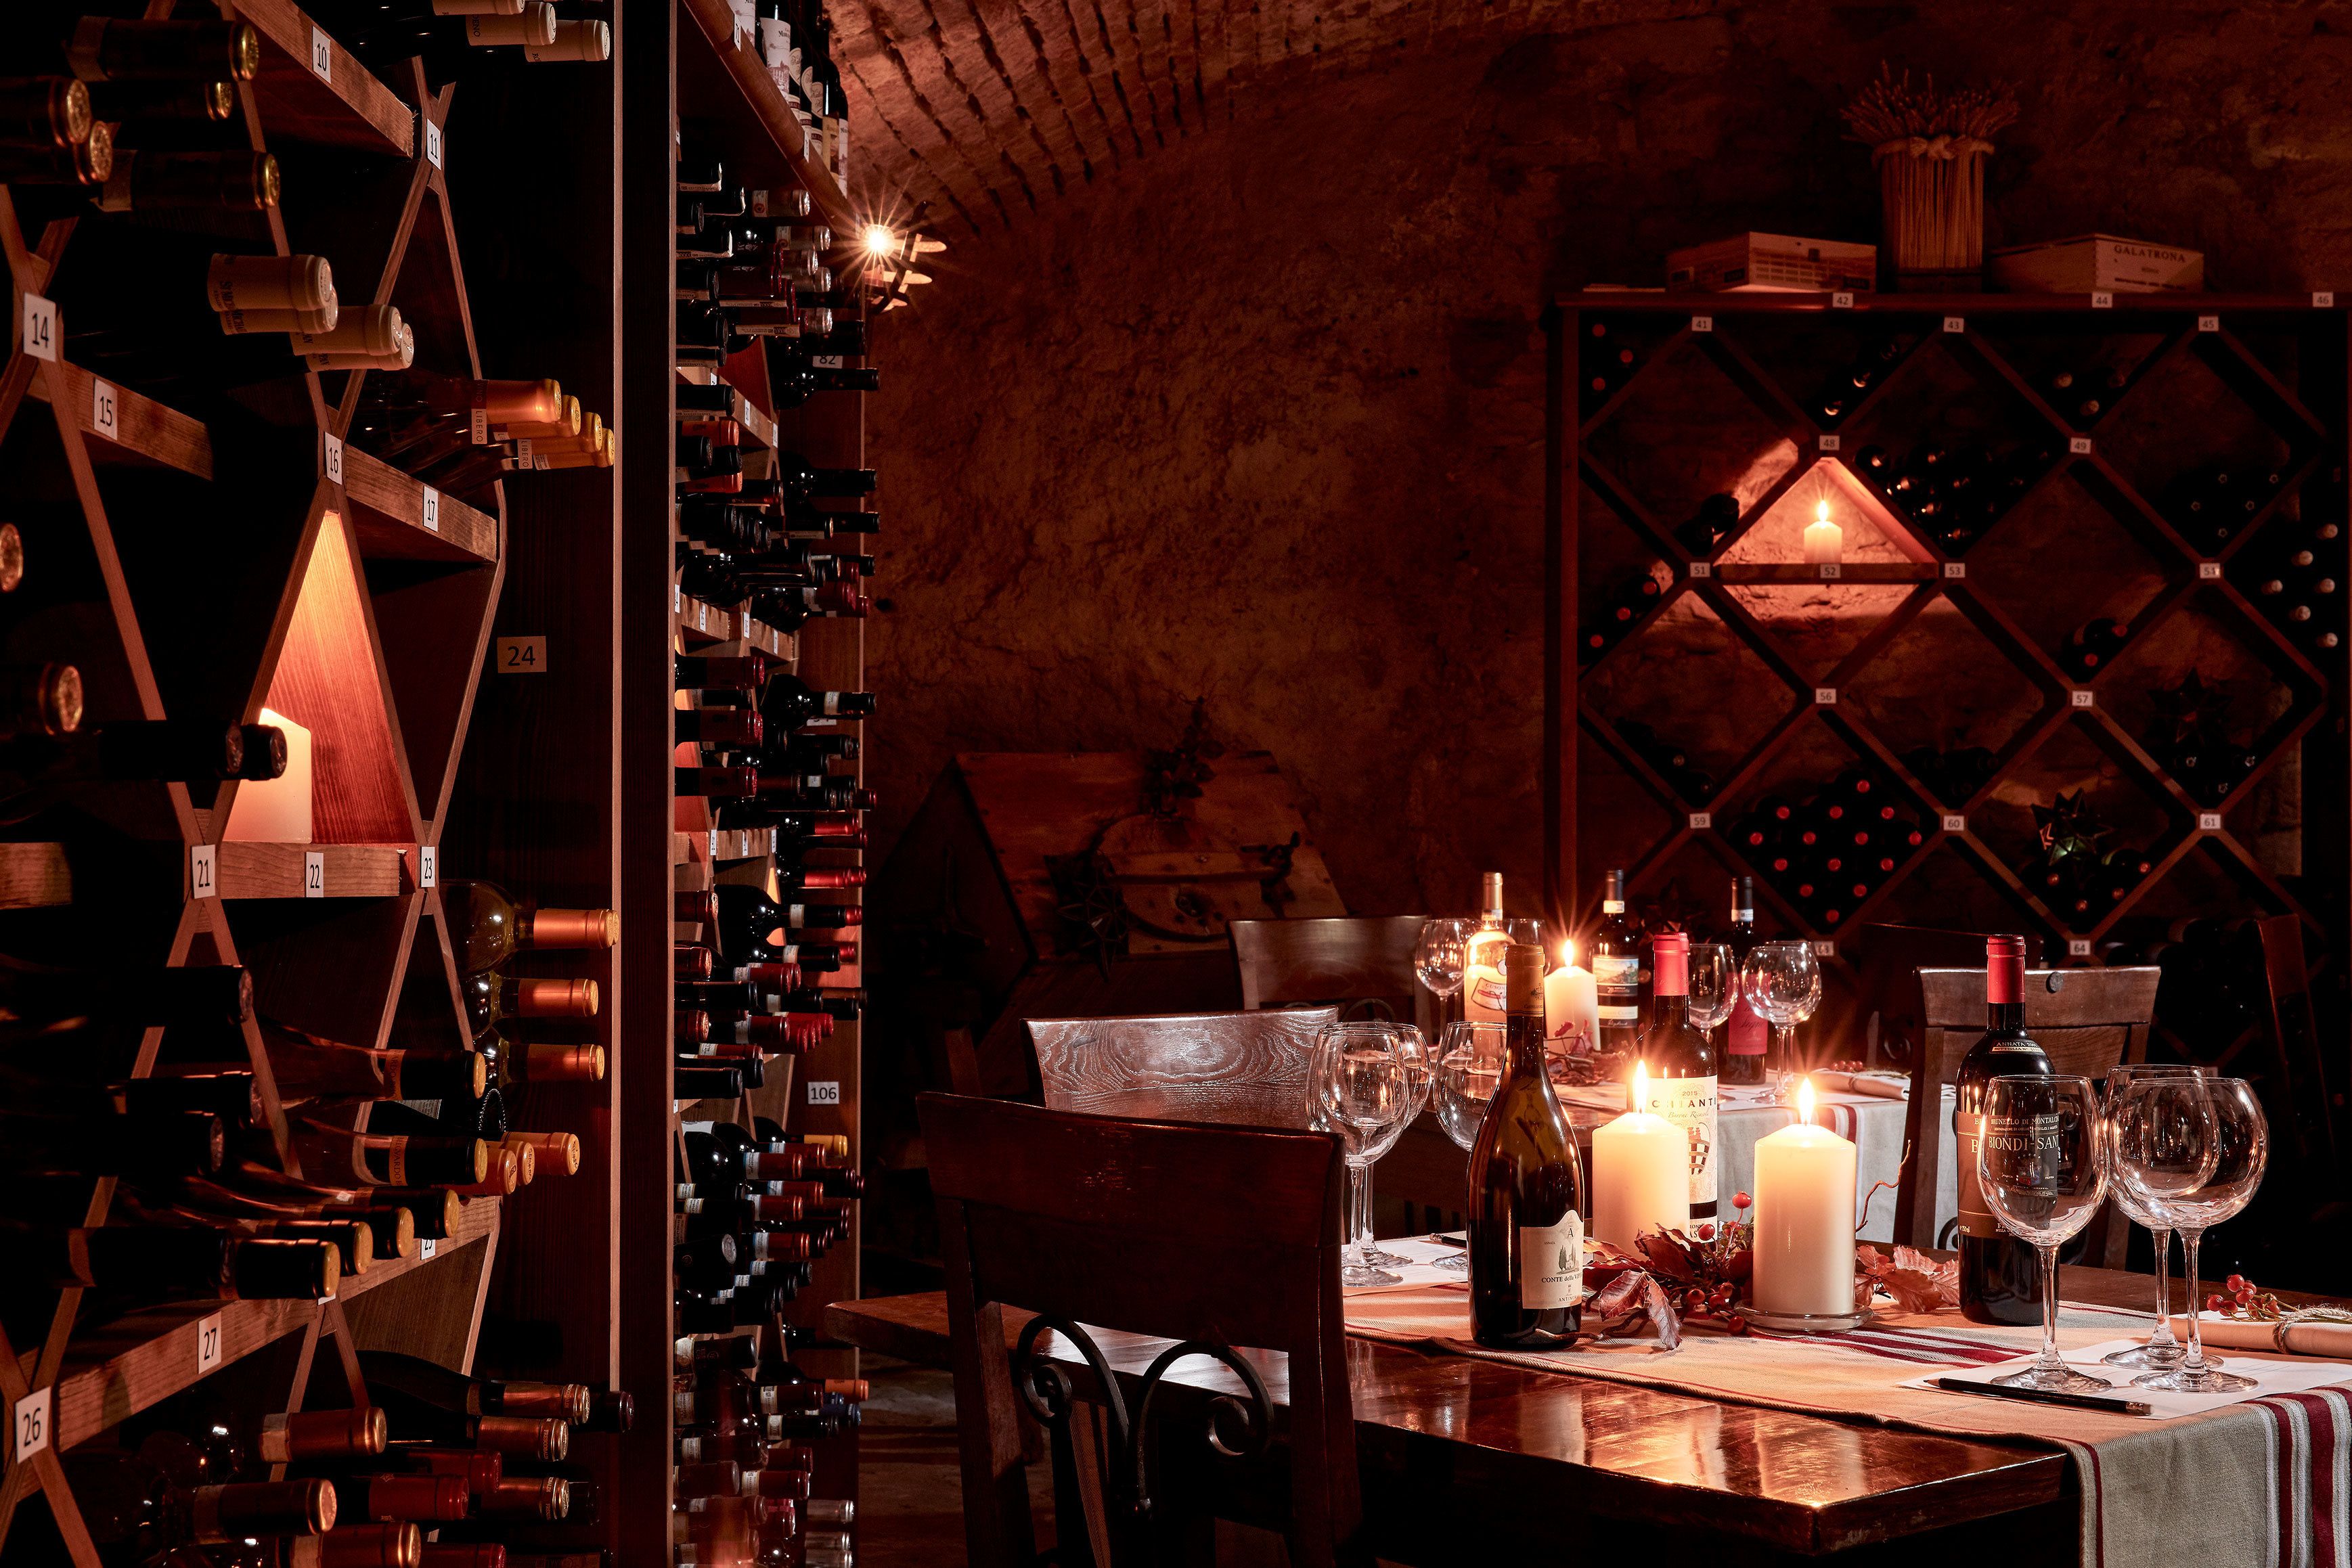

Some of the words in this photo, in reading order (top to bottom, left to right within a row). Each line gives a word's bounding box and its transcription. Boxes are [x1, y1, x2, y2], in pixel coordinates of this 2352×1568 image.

[315, 45, 328, 73] 10
[428, 133, 439, 160] 11
[2114, 244, 2185, 263] GALATRONA
[1836, 295, 1849, 306] 42
[2095, 295, 2108, 306] 44
[2316, 295, 2330, 305] 46
[1696, 319, 1708, 330] 41
[1947, 320, 1959, 330] 43
[2202, 318, 2215, 330] 45
[30, 313, 49, 349] 14
[819, 354, 836, 365] 82
[99, 395, 113, 428] 15
[475, 410, 484, 442] LIBERO
[1823, 438, 1836, 448] 48
[2074, 441, 2087, 451] 49
[521, 440, 529, 468] LIBERO
[328, 447, 339, 473] 16
[426, 499, 436, 521] 17
[1694, 565, 1706, 576] 51
[1824, 566, 1837, 576] 52
[1949, 565, 1961, 576] 53
[507, 644, 536, 667] 24
[1820, 692, 1832, 702] 56
[2077, 694, 2089, 704] 57
[1693, 816, 1706, 826] 59
[1947, 818, 1960, 829] 60
[2204, 817, 2216, 827] 61
[197, 859, 210, 887] 21
[424, 857, 432, 879] 23
[309, 864, 320, 889] 22
[2073, 943, 2086, 953] 64
[809, 1085, 837, 1101] 106
[1689, 1108, 1710, 1119] Ricasoli
[203, 1327, 217, 1360] 27
[22, 1407, 41, 1446] 26
